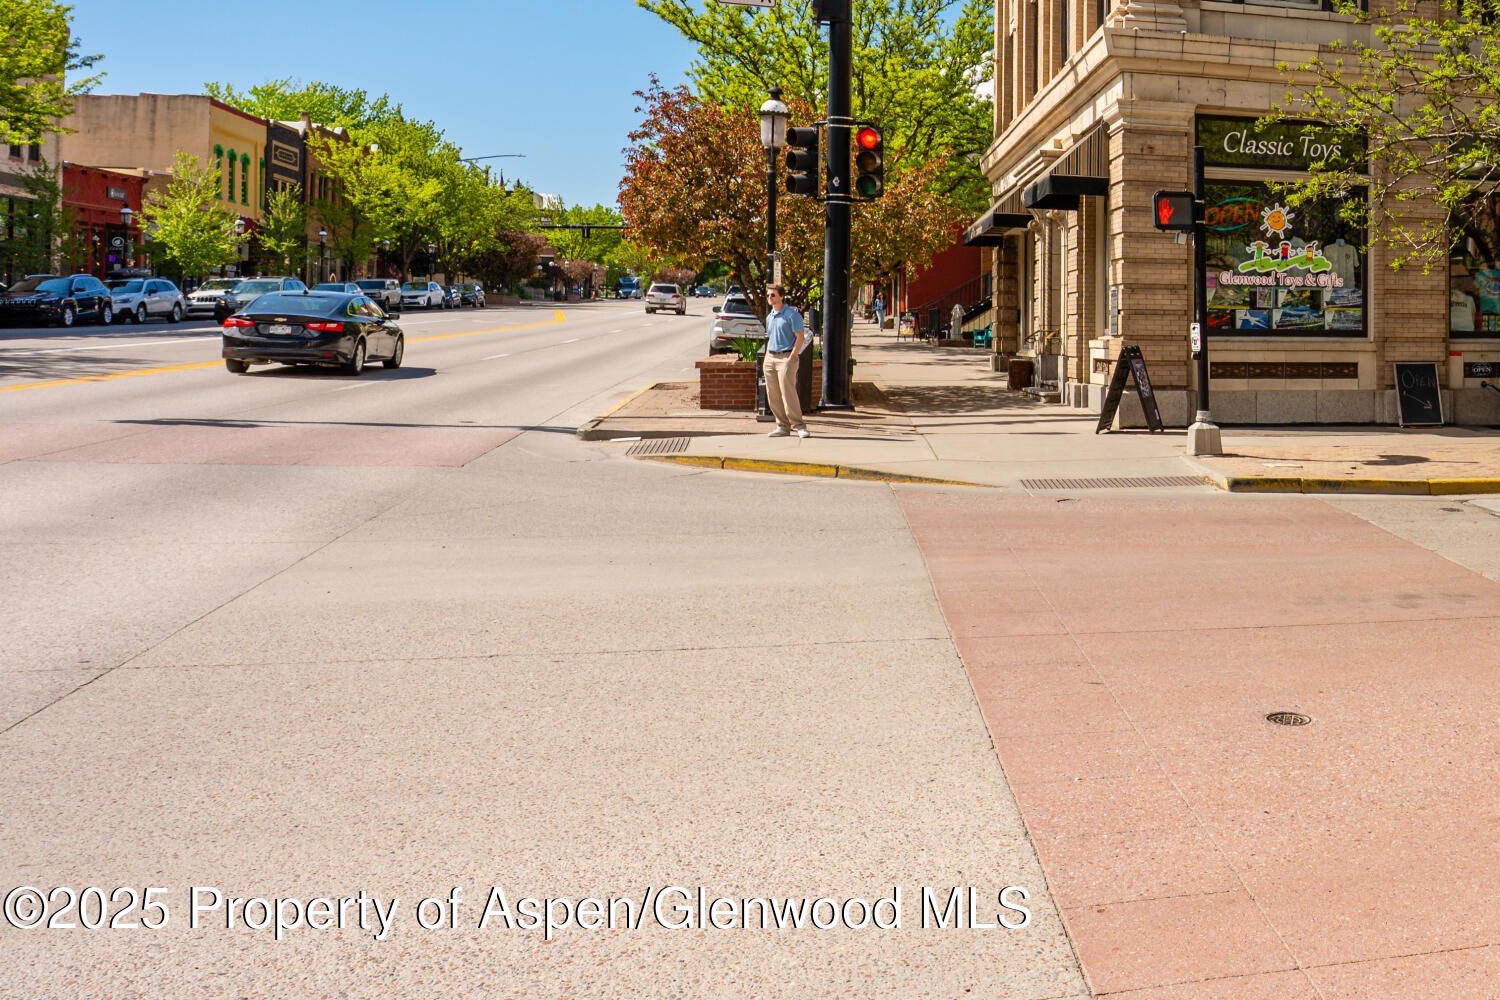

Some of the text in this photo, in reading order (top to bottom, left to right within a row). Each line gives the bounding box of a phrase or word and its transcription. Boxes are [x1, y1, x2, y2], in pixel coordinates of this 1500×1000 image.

[1223, 129, 1342, 161] Classic Toys
[1205, 203, 1260, 225] OPEN
[1219, 270, 1344, 290] Glenwood Toys & Gifts
